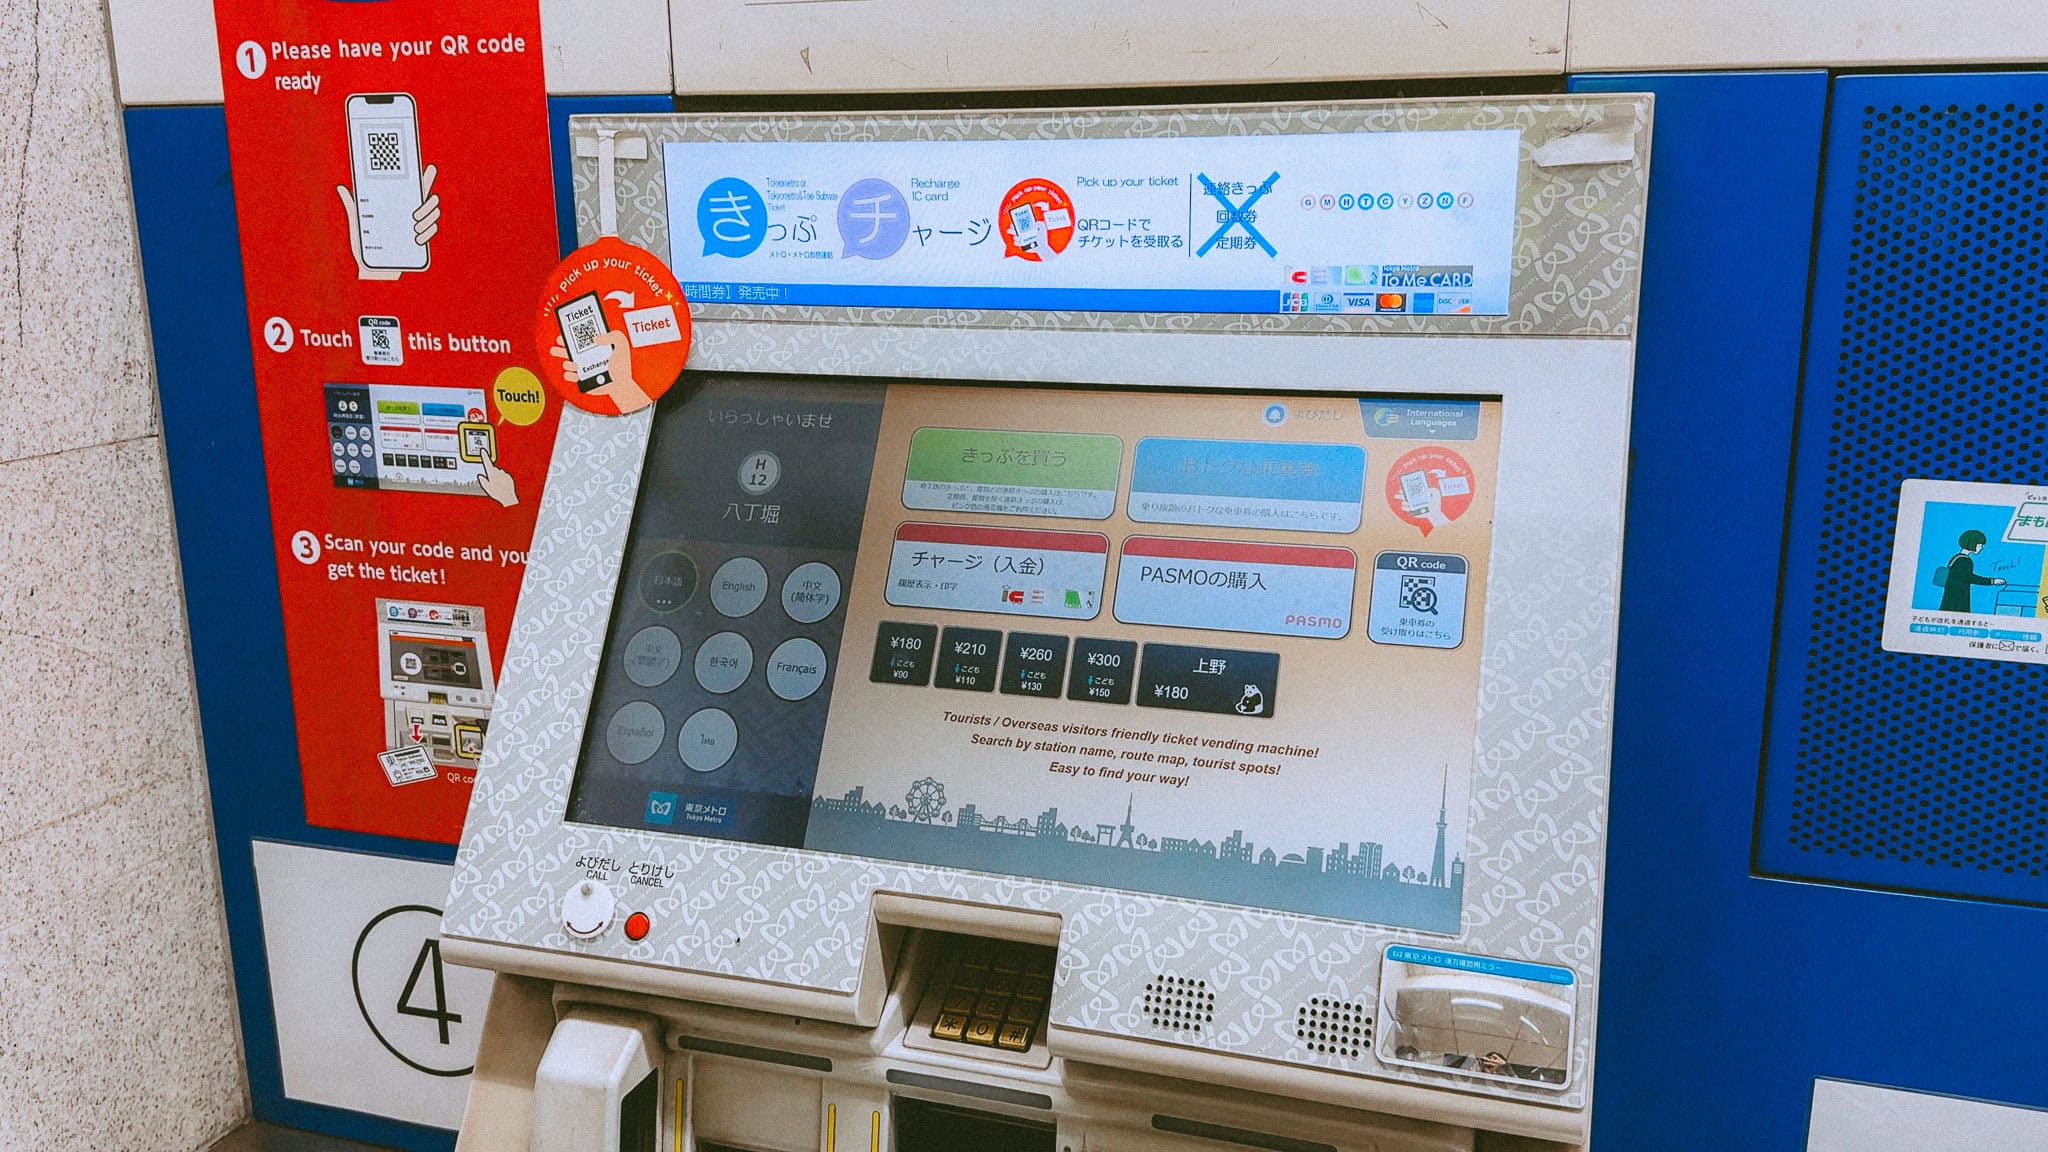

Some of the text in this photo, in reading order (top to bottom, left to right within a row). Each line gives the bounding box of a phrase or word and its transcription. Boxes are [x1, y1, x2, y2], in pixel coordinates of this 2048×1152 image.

[245, 33, 526, 72] 1 Please have your QR code
[275, 72, 321, 94] ready
[911, 177, 960, 189] Recharge
[1077, 176, 1179, 188] Pick up your ticket
[912, 191, 949, 201] IC card
[1077, 218, 1151, 232] QRコードで
[1078, 235, 1183, 249] チケットを受取る
[1216, 236, 1257, 250] 定期券
[560, 257, 664, 297] Pick up your ticket
[1383, 273, 1472, 288] To Me CARD
[1348, 298, 1371, 307] VISA
[566, 305, 594, 322] Ticket
[368, 319, 378, 327] QR
[632, 317, 671, 333] Ticket
[273, 323, 511, 353] 2 Touch this button
[497, 389, 540, 403] Touch!
[708, 410, 833, 429] いらっしゃいませ
[1406, 409, 1463, 418] International
[1410, 419, 1457, 427] Languages
[962, 447, 1067, 467] きっぷを買う
[756, 459, 767, 470] H
[749, 474, 767, 486] 12
[723, 503, 781, 524] 八丁堀
[300, 534, 529, 567] 3 Scan your code and you
[1397, 556, 1446, 570] QR code
[328, 562, 354, 580] get
[359, 563, 385, 579] the
[1140, 566, 1267, 591] PASMOの購入
[722, 581, 756, 593] English
[802, 581, 822, 591] 中文
[1285, 614, 1343, 630] PASMO
[1380, 628, 1451, 640] 受け取りはこちら
[890, 637, 921, 650] ¥180
[954, 642, 986, 656] ¥210
[1020, 647, 1052, 661] ¥260
[1087, 653, 1120, 668] ¥300
[709, 656, 739, 669] 한국어
[776, 661, 817, 675] Français
[897, 659, 915, 668] こども
[1193, 658, 1227, 675] 上野
[961, 666, 980, 674] こども
[1027, 672, 1046, 680] こども
[955, 676, 976, 685] ¥110
[1021, 681, 1042, 691] ¥130
[1094, 677, 1114, 686] こども
[1089, 687, 1110, 697] ¥150
[1154, 685, 1189, 700] ¥180
[943, 711, 991, 726] Tourists
[1002, 717, 1058, 732] Overseas
[1062, 723, 1108, 737] visitors
[1111, 727, 1159, 744] friendly
[1162, 732, 1198, 746] ticket
[1201, 737, 1254, 754] vending
[1256, 743, 1319, 758] machine!
[971, 733, 1281, 776] Search by station name, route map, tourist spots!
[447, 773, 461, 784] QR
[1049, 761, 1190, 788] Easy to find your way!
[685, 803, 727, 816] 東京メトロ
[686, 814, 722, 823] Tokyo Metro
[575, 856, 675, 879] よびだし とりけし
[586, 870, 664, 888] CALL CANCEL
[1404, 951, 1441, 963] 東京メトロ
[397, 938, 462, 1045] 4
[976, 1022, 1021, 1042] 0 #
